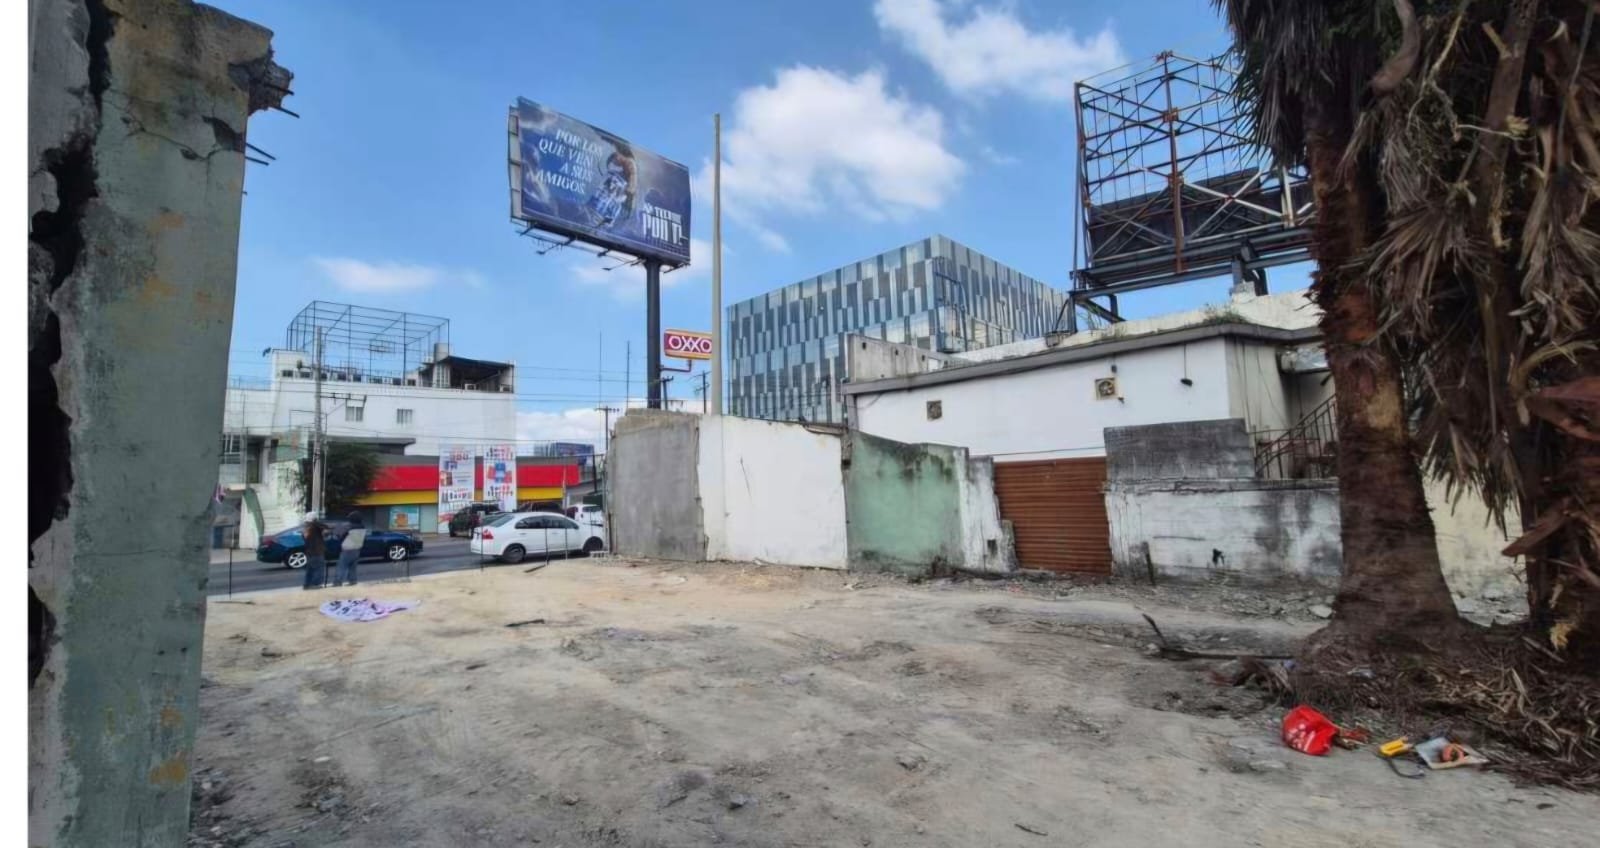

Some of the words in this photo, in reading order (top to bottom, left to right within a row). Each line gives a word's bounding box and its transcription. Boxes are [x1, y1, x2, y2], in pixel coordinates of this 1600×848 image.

[555, 129, 580, 147] POR
[539, 137, 566, 157] QUE
[569, 148, 596, 168] VEN
[560, 161, 568, 174] A
[571, 164, 593, 183] SUS
[668, 335, 712, 353] OXXO
